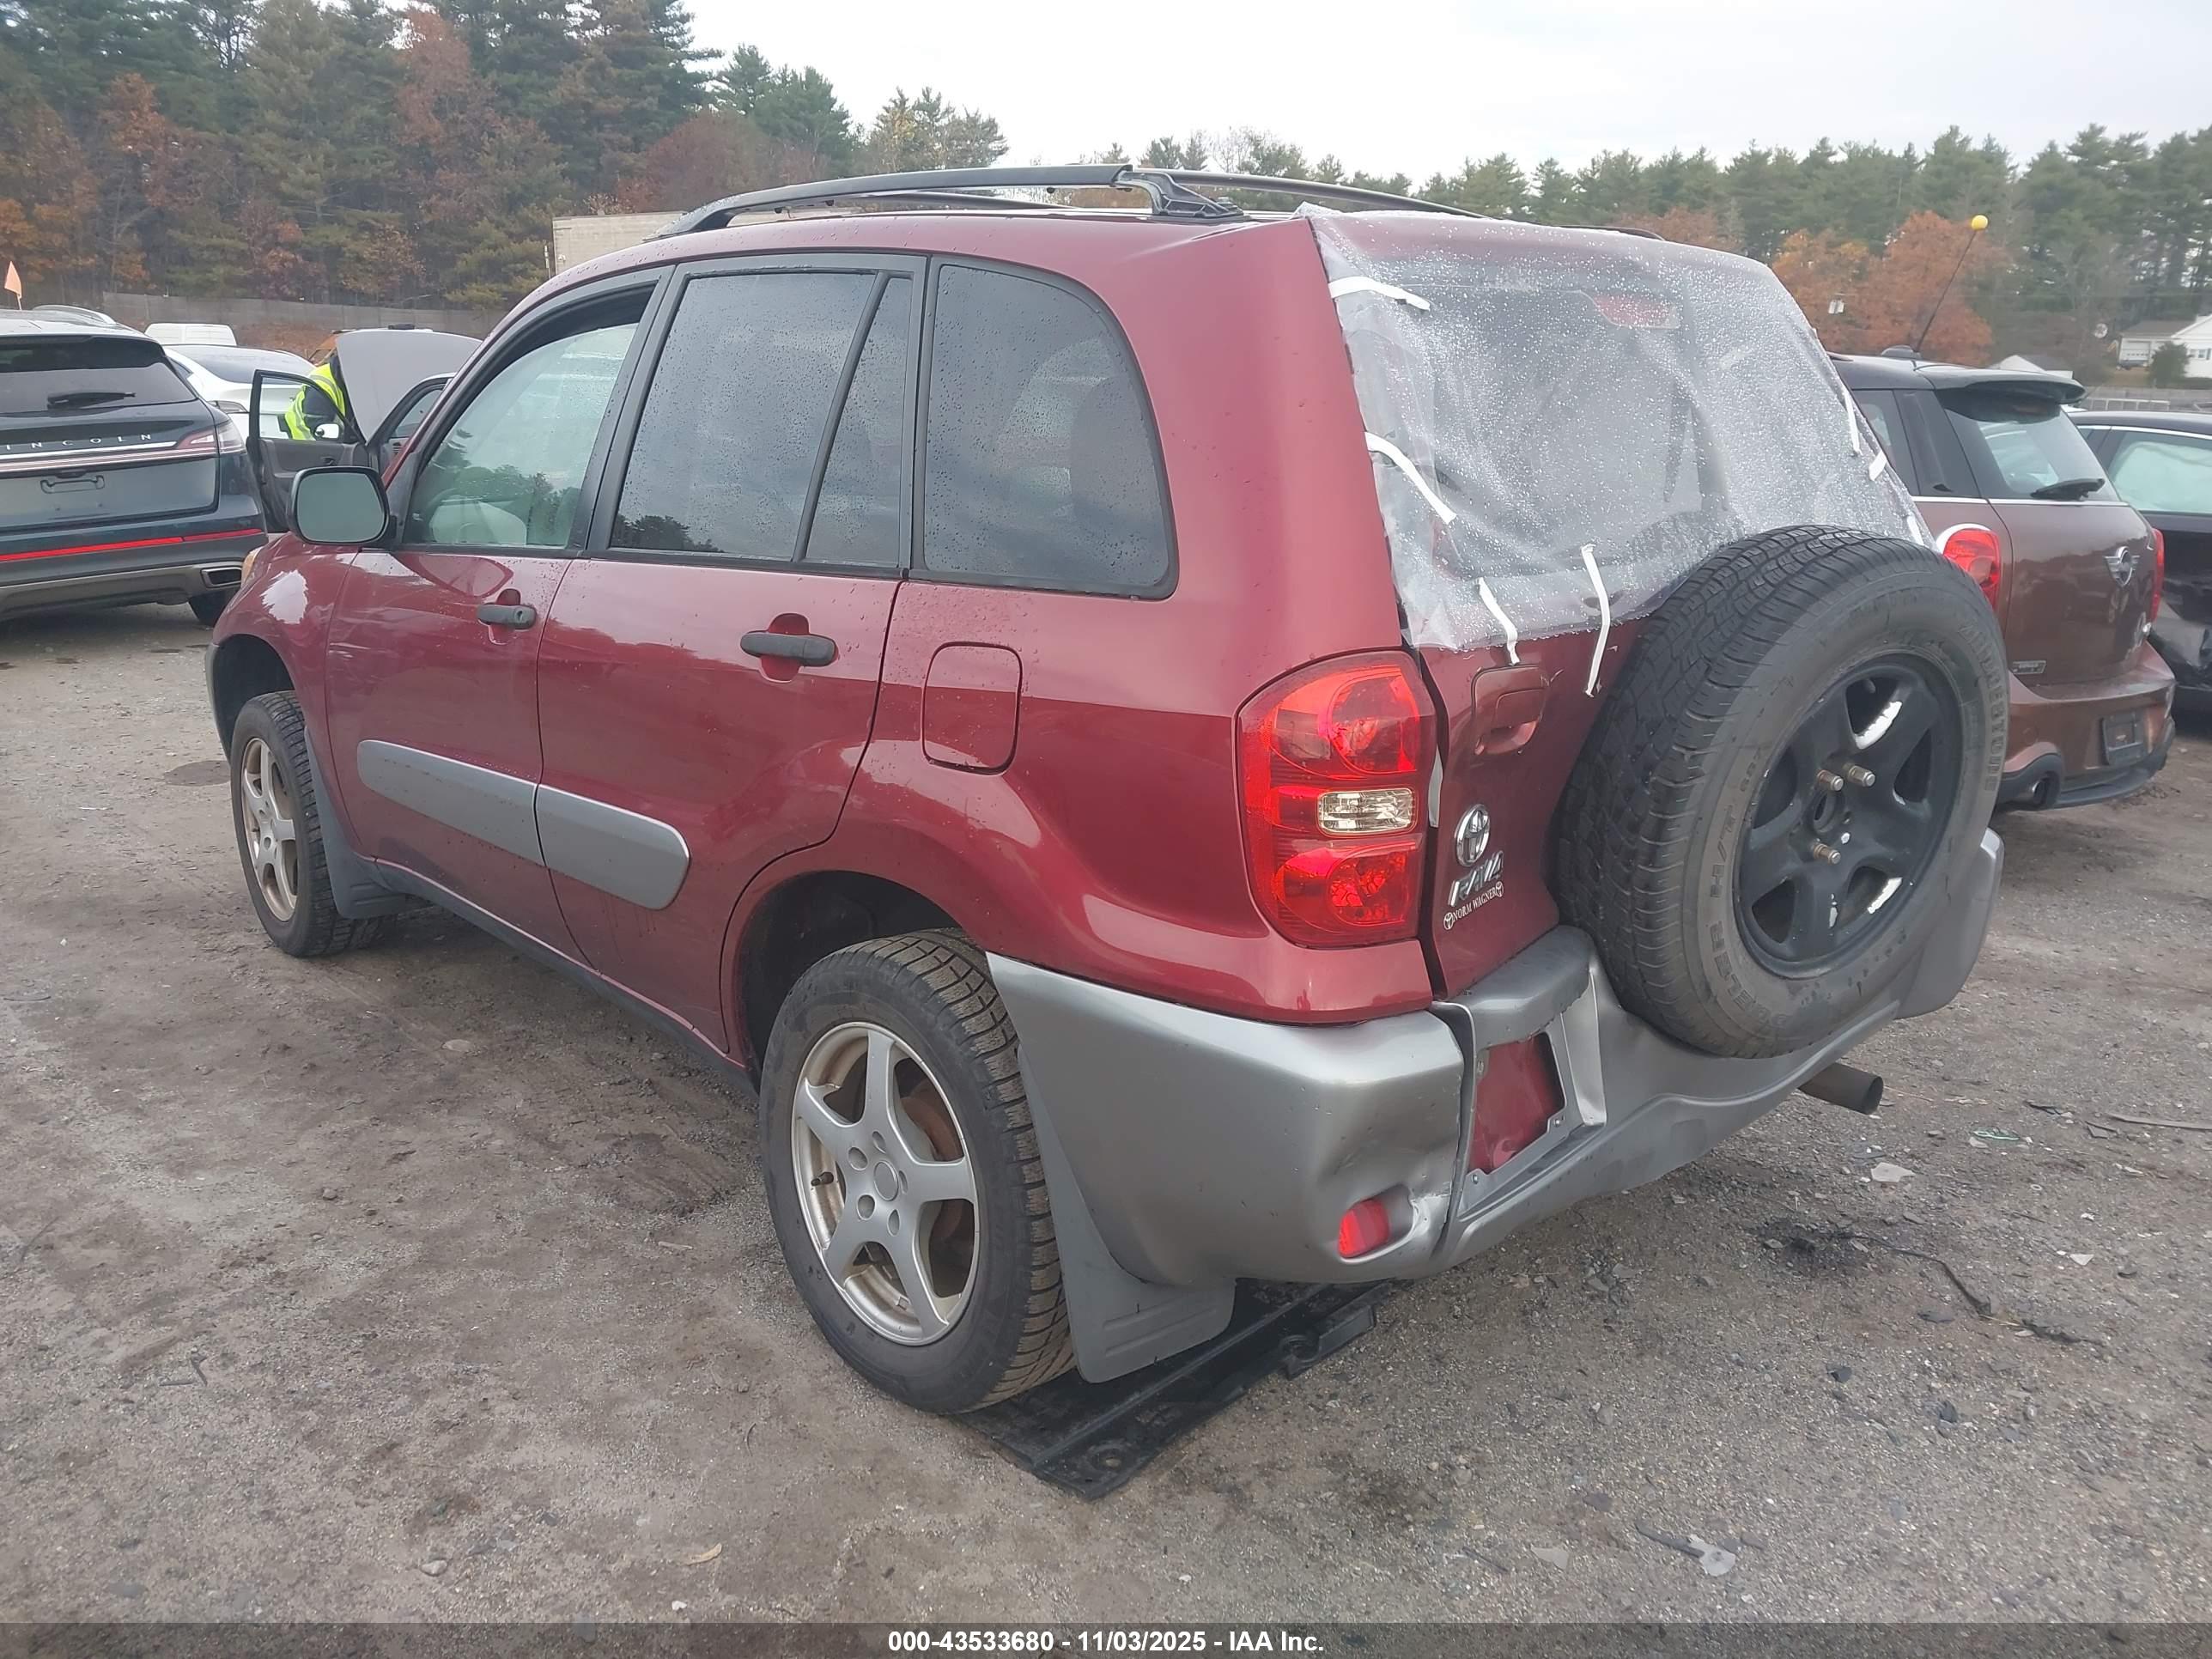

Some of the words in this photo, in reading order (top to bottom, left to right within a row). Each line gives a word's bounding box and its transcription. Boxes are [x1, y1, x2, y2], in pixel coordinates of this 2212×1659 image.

[5, 434, 152, 451] INCOLN
[1710, 804, 1737, 898] H/T
[1448, 850, 1504, 907] RAV4
[1452, 902, 1473, 923] NORM
[1473, 886, 1498, 910] WAGNER
